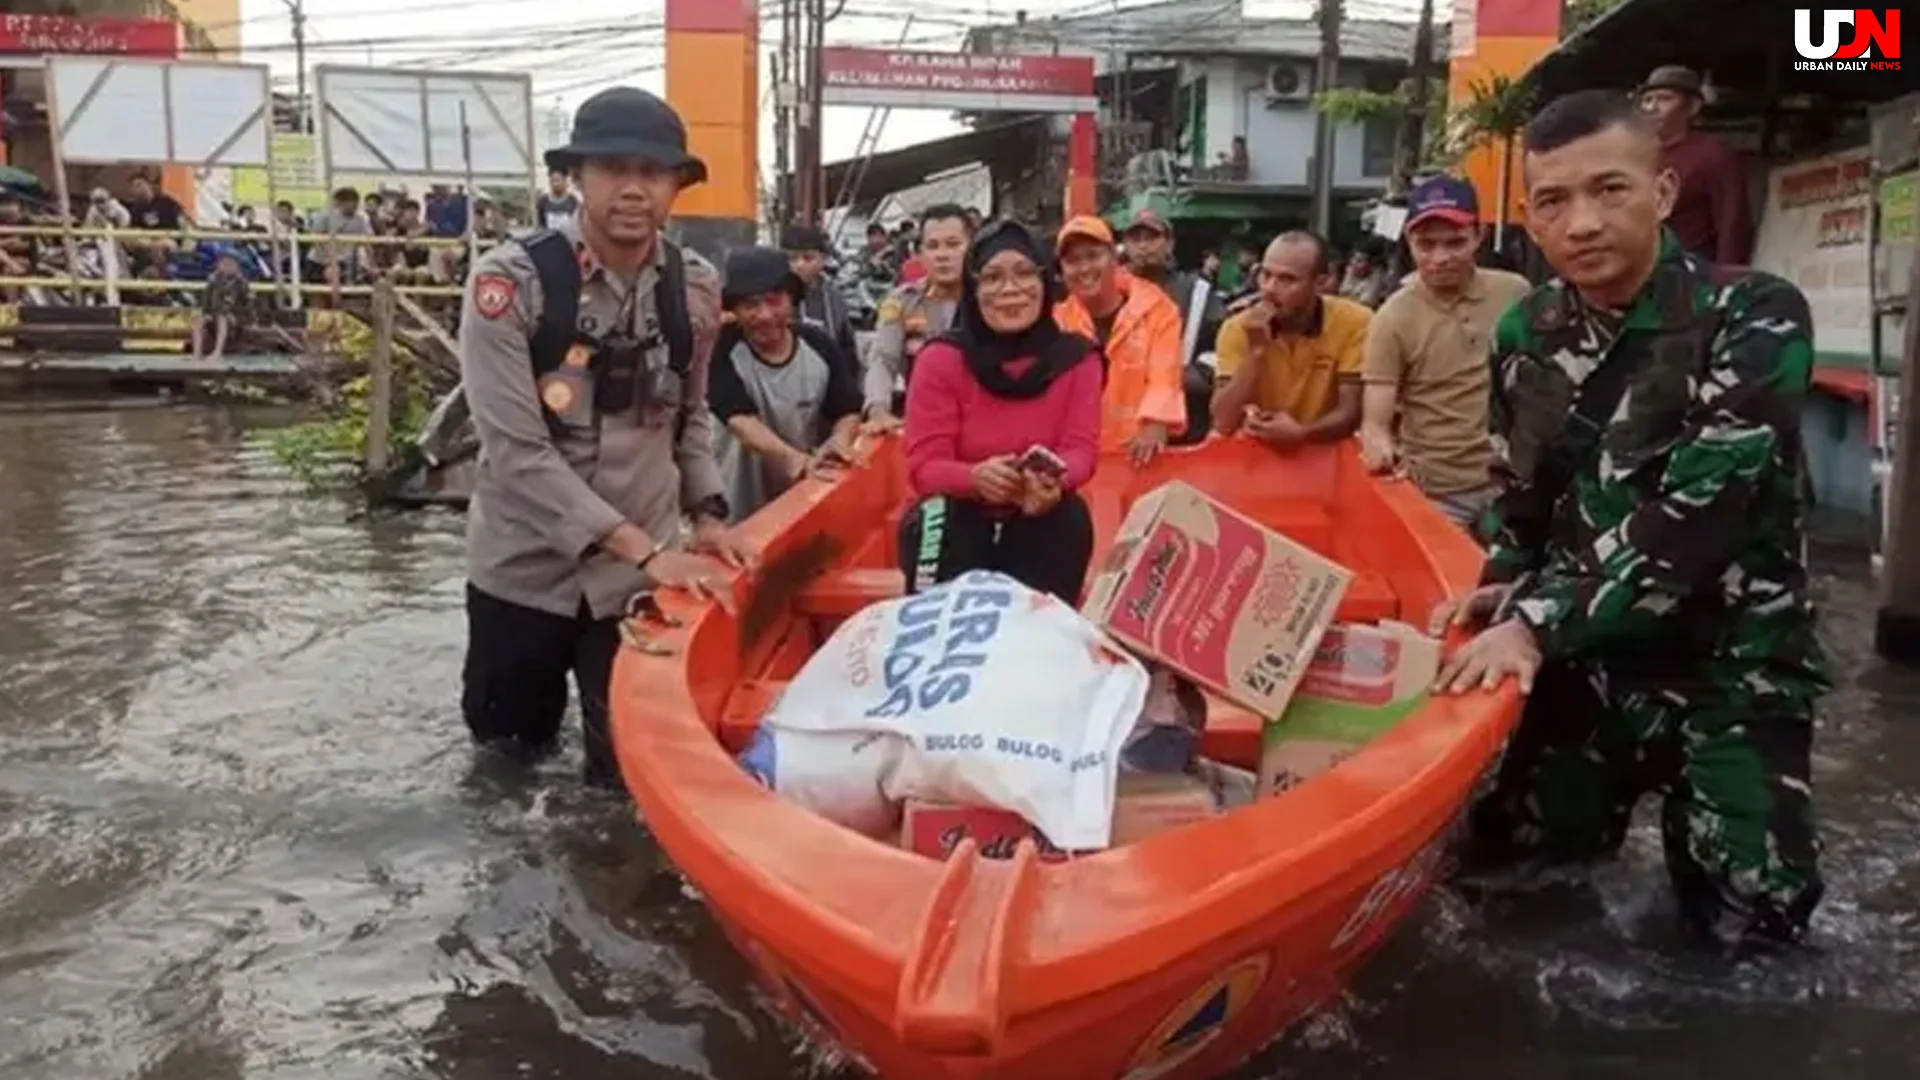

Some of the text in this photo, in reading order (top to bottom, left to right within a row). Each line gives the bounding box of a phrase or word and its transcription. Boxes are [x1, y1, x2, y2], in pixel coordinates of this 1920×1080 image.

[864, 591, 949, 718] ULOG
[924, 733, 984, 751] BULOG
[996, 736, 1064, 764] BULOG
